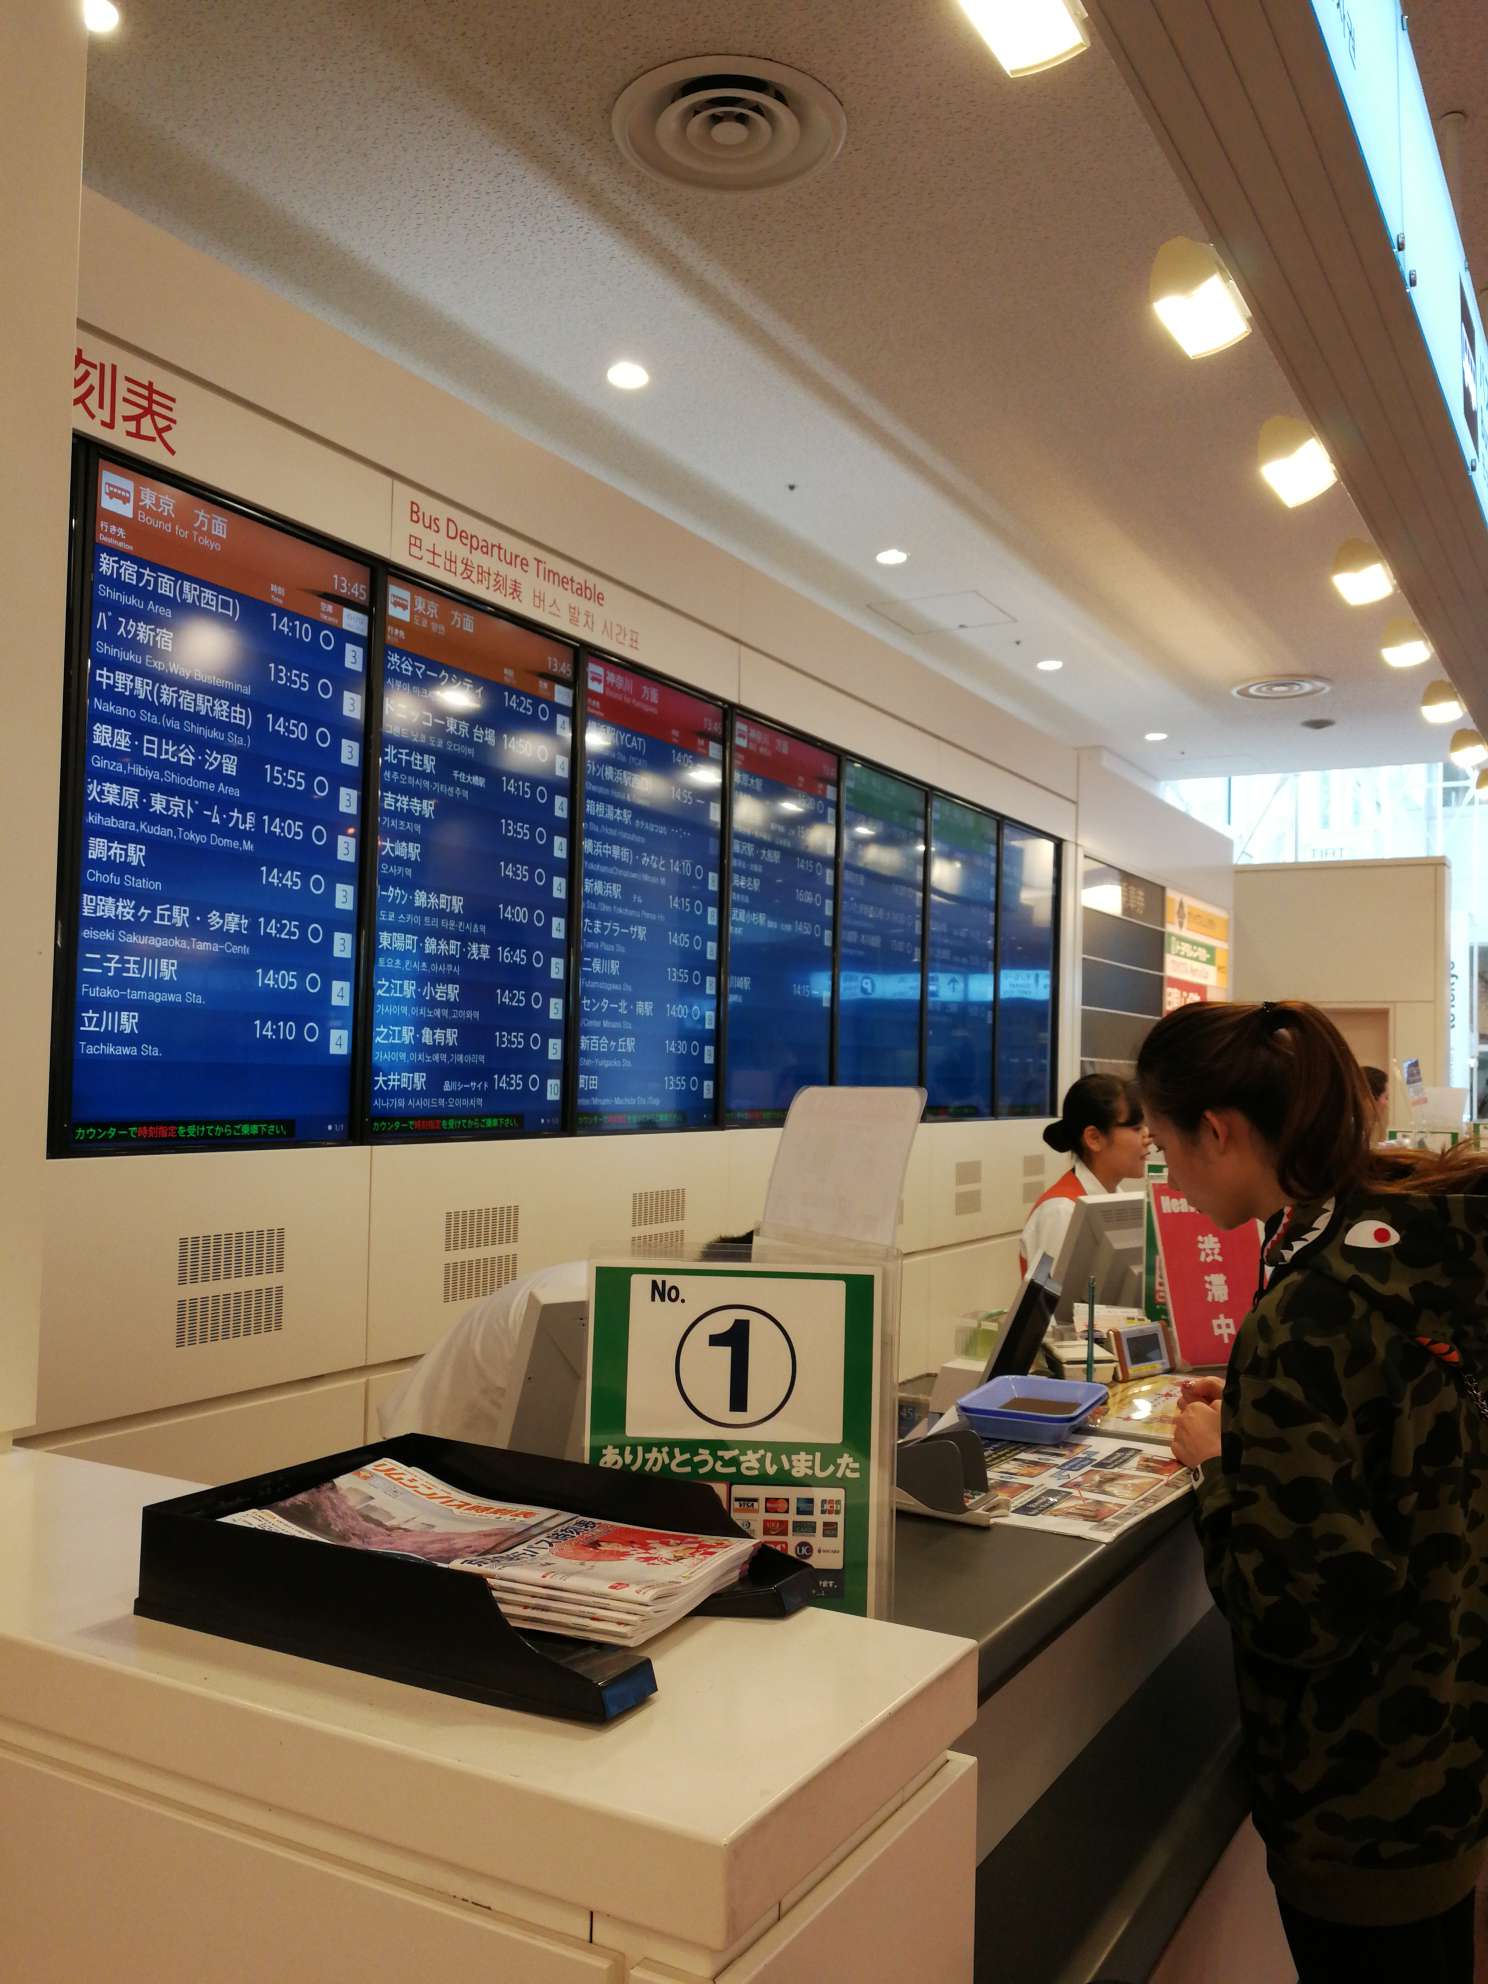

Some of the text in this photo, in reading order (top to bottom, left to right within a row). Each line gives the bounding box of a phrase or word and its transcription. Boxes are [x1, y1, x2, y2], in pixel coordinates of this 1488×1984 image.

[139, 486, 228, 539] 東京 方面
[138, 511, 221, 552] Bound for Tokyo
[410, 500, 605, 607] Bus Departure Timetable
[408, 534, 524, 604] 巴士出发时刻表
[99, 552, 240, 622] 新宿方面(駅西口)
[333, 574, 367, 600] 13:45
[98, 584, 172, 618] Shinjuku Area
[414, 596, 474, 633] 東京 方面
[533, 587, 641, 651] 버스 발차 시간표
[270, 612, 311, 642] 14:10
[96, 641, 142, 664] Shinjuku
[269, 663, 309, 691] 13:55
[387, 651, 485, 698] 渋谷マークシティ
[95, 667, 252, 729] 中野駅(新宿駅経由)
[503, 691, 533, 715] 14:25
[94, 697, 136, 719] Nakano
[183, 721, 224, 741] Shinjuku
[266, 713, 307, 741] 14:50
[473, 724, 496, 747] 台場
[384, 744, 436, 775] 北千住駅
[265, 764, 305, 790] 15:55
[502, 776, 531, 799] 14:15
[218, 783, 240, 797] Area
[383, 792, 435, 819] 吉祥寺駅
[86, 812, 207, 844] kihabara,Kudan,Tokyo
[262, 815, 303, 840] 14:05
[501, 819, 530, 840] 13:55
[88, 837, 146, 867] 調布駅
[381, 838, 421, 862] 大崎駅
[87, 870, 162, 891] Chofu Station
[260, 866, 301, 890] 14:45
[500, 861, 529, 882] 14:35
[584, 878, 622, 899] 新横浜駅
[499, 904, 528, 924] 14:00
[669, 895, 690, 912] 14:15
[82, 928, 115, 941] eiseki
[258, 917, 299, 940] 14:25
[82, 953, 177, 981] 二子玉川駅
[498, 946, 527, 965] 16:45
[256, 968, 297, 989] 14:05
[667, 967, 689, 984] 13:55
[81, 984, 206, 1004] Futako-tamagawa Sta.
[496, 989, 525, 1007] 14:25
[80, 1010, 139, 1034] 立川駅
[666, 1003, 688, 1018] 14:00
[254, 1020, 296, 1040] 14:10
[494, 1031, 524, 1048] 13:55
[79, 1041, 163, 1056] Tachikawa Sta.
[580, 1035, 636, 1052] 新百合ヶ丘駅
[665, 1039, 687, 1054] 14:30
[374, 1072, 427, 1091] 大井町駅
[493, 1074, 523, 1091] 14:35
[579, 1074, 598, 1090] 町田
[664, 1076, 686, 1091] 13:55
[650, 1279, 686, 1304] No.
[708, 1318, 751, 1413] 1
[599, 1444, 861, 1480] ありがとうございました
